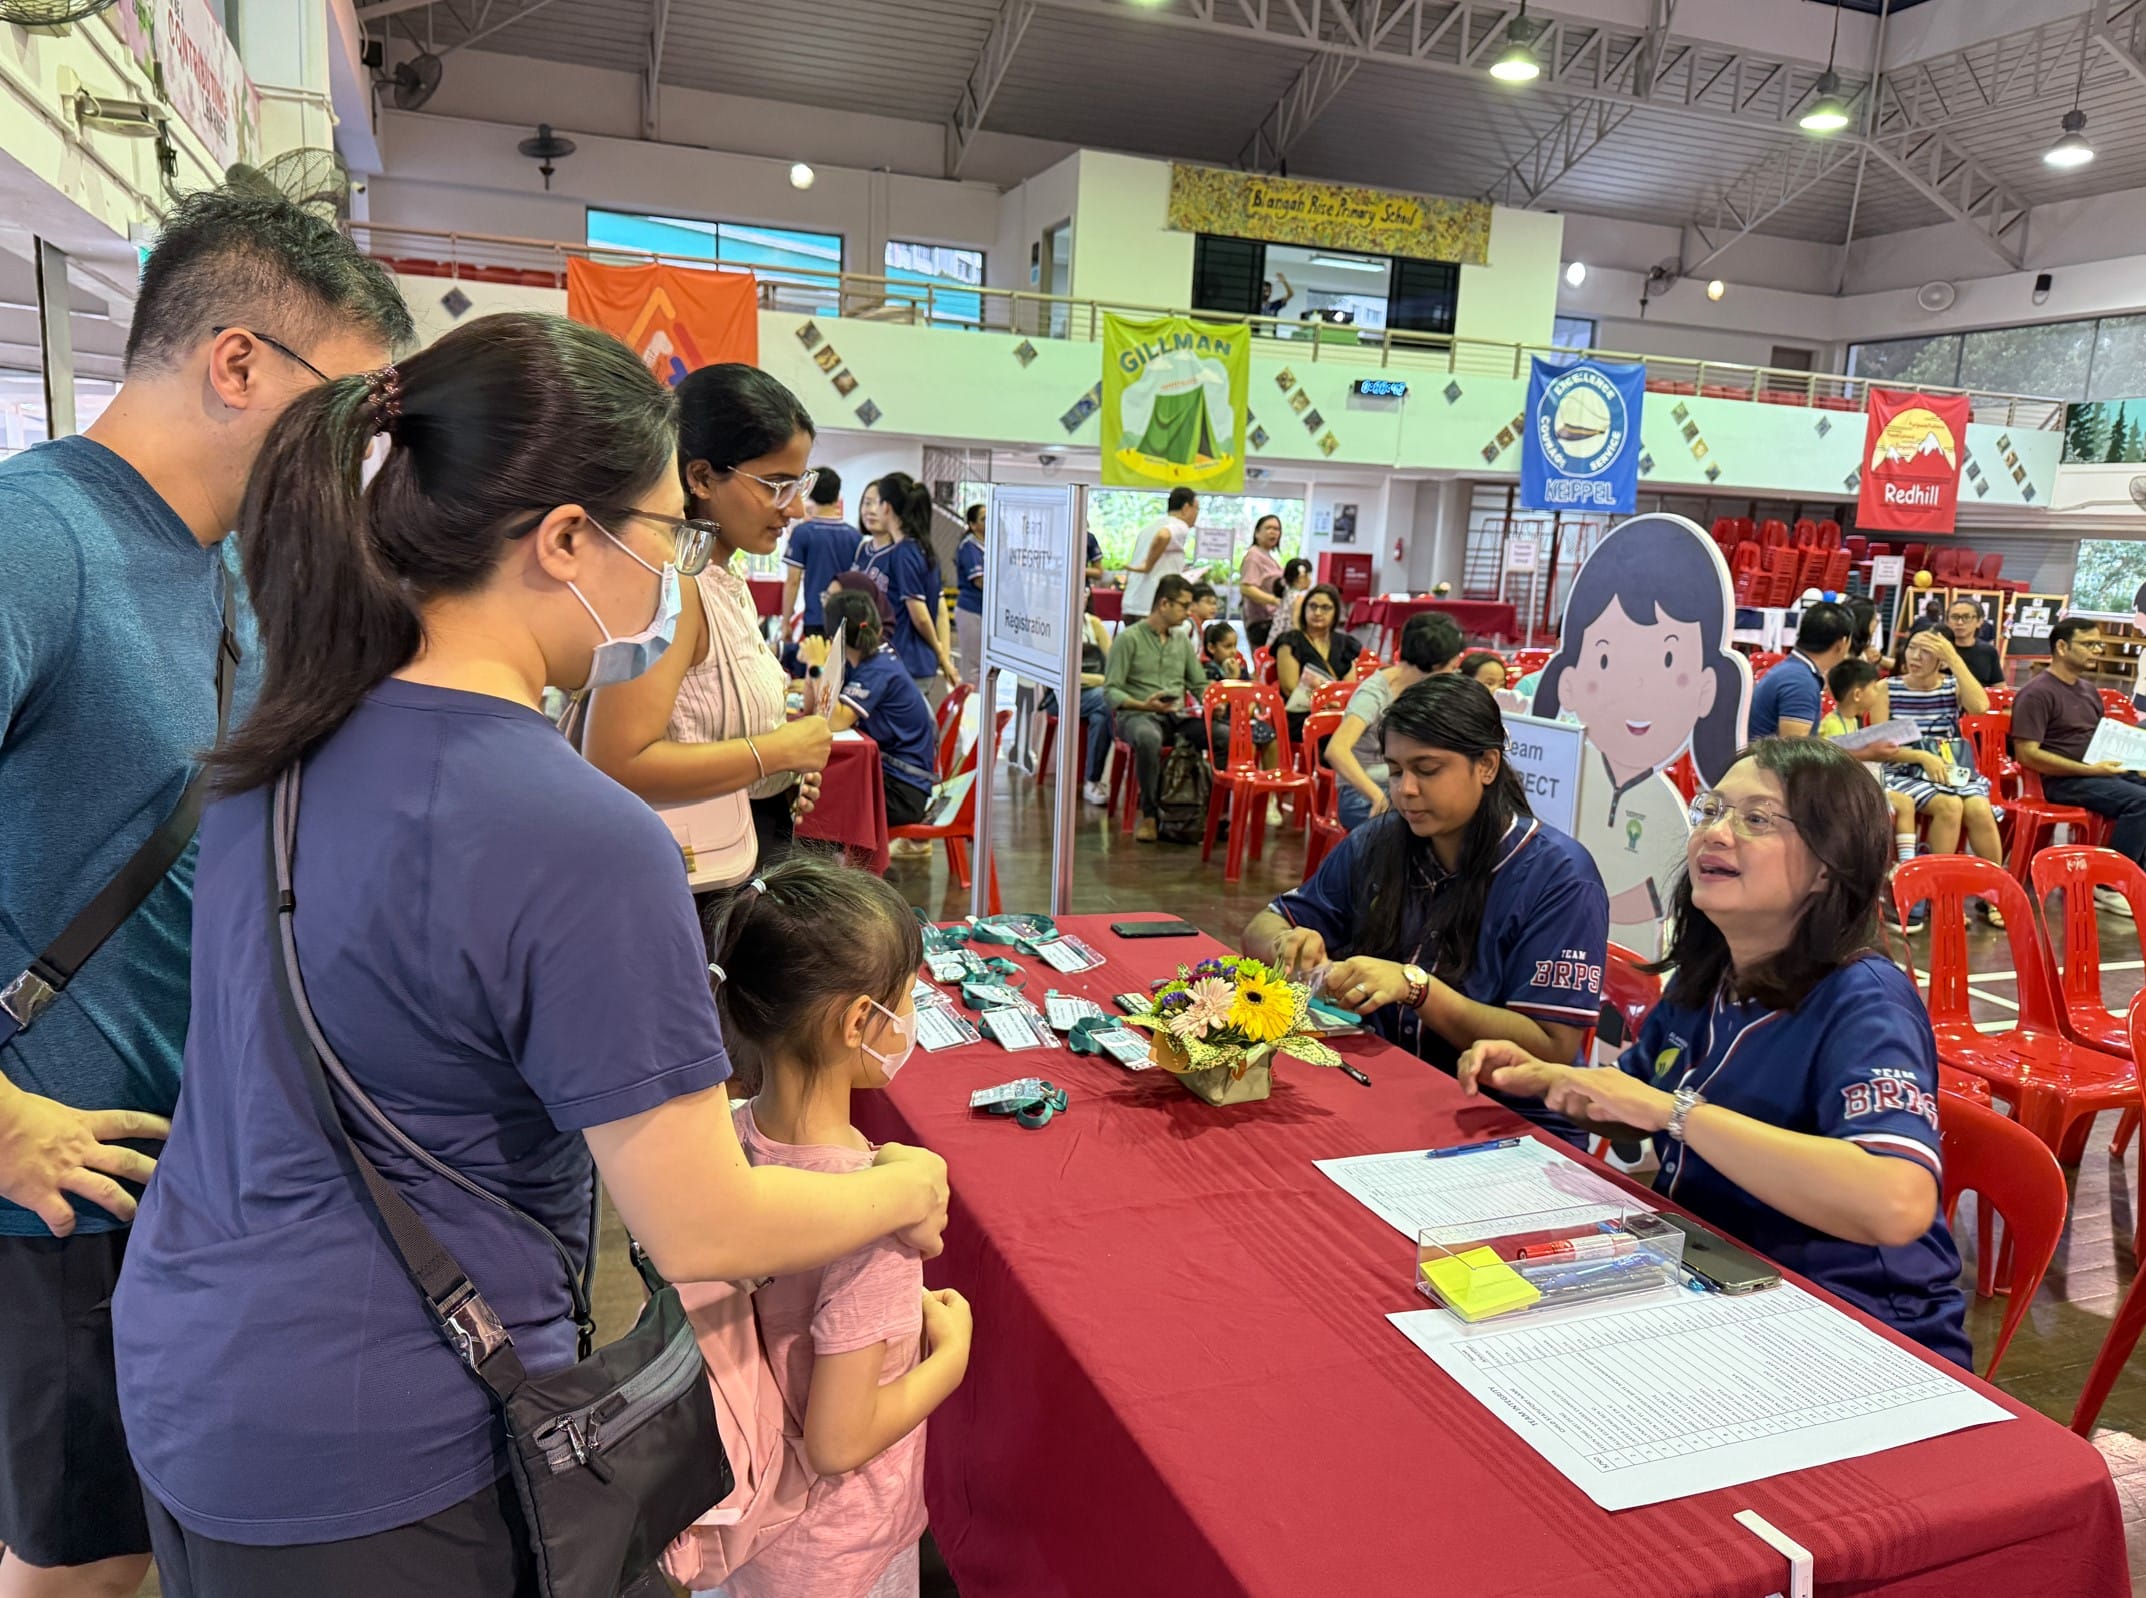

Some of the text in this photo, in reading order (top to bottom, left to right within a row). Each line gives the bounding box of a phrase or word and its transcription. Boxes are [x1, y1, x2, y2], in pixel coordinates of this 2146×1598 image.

[168, 8, 228, 121] CONTRIBUTING
[1252, 189, 1305, 220] Blangah
[1308, 195, 1334, 216] Rise
[1119, 333, 1232, 373] GILLMAN
[1541, 415, 1566, 469] COURAGE
[1589, 430, 1621, 471] SERVICE
[1544, 478, 1616, 505] KEPPEL
[1884, 482, 1940, 506] Redhill
[1009, 547, 1053, 571] INTEGRITY
[1004, 609, 1051, 638] Registration
[1511, 741, 1543, 761] eam
[1561, 949, 1586, 960] TEAM
[1530, 960, 1601, 993] BRPS
[1871, 1068, 1918, 1080] TEAM
